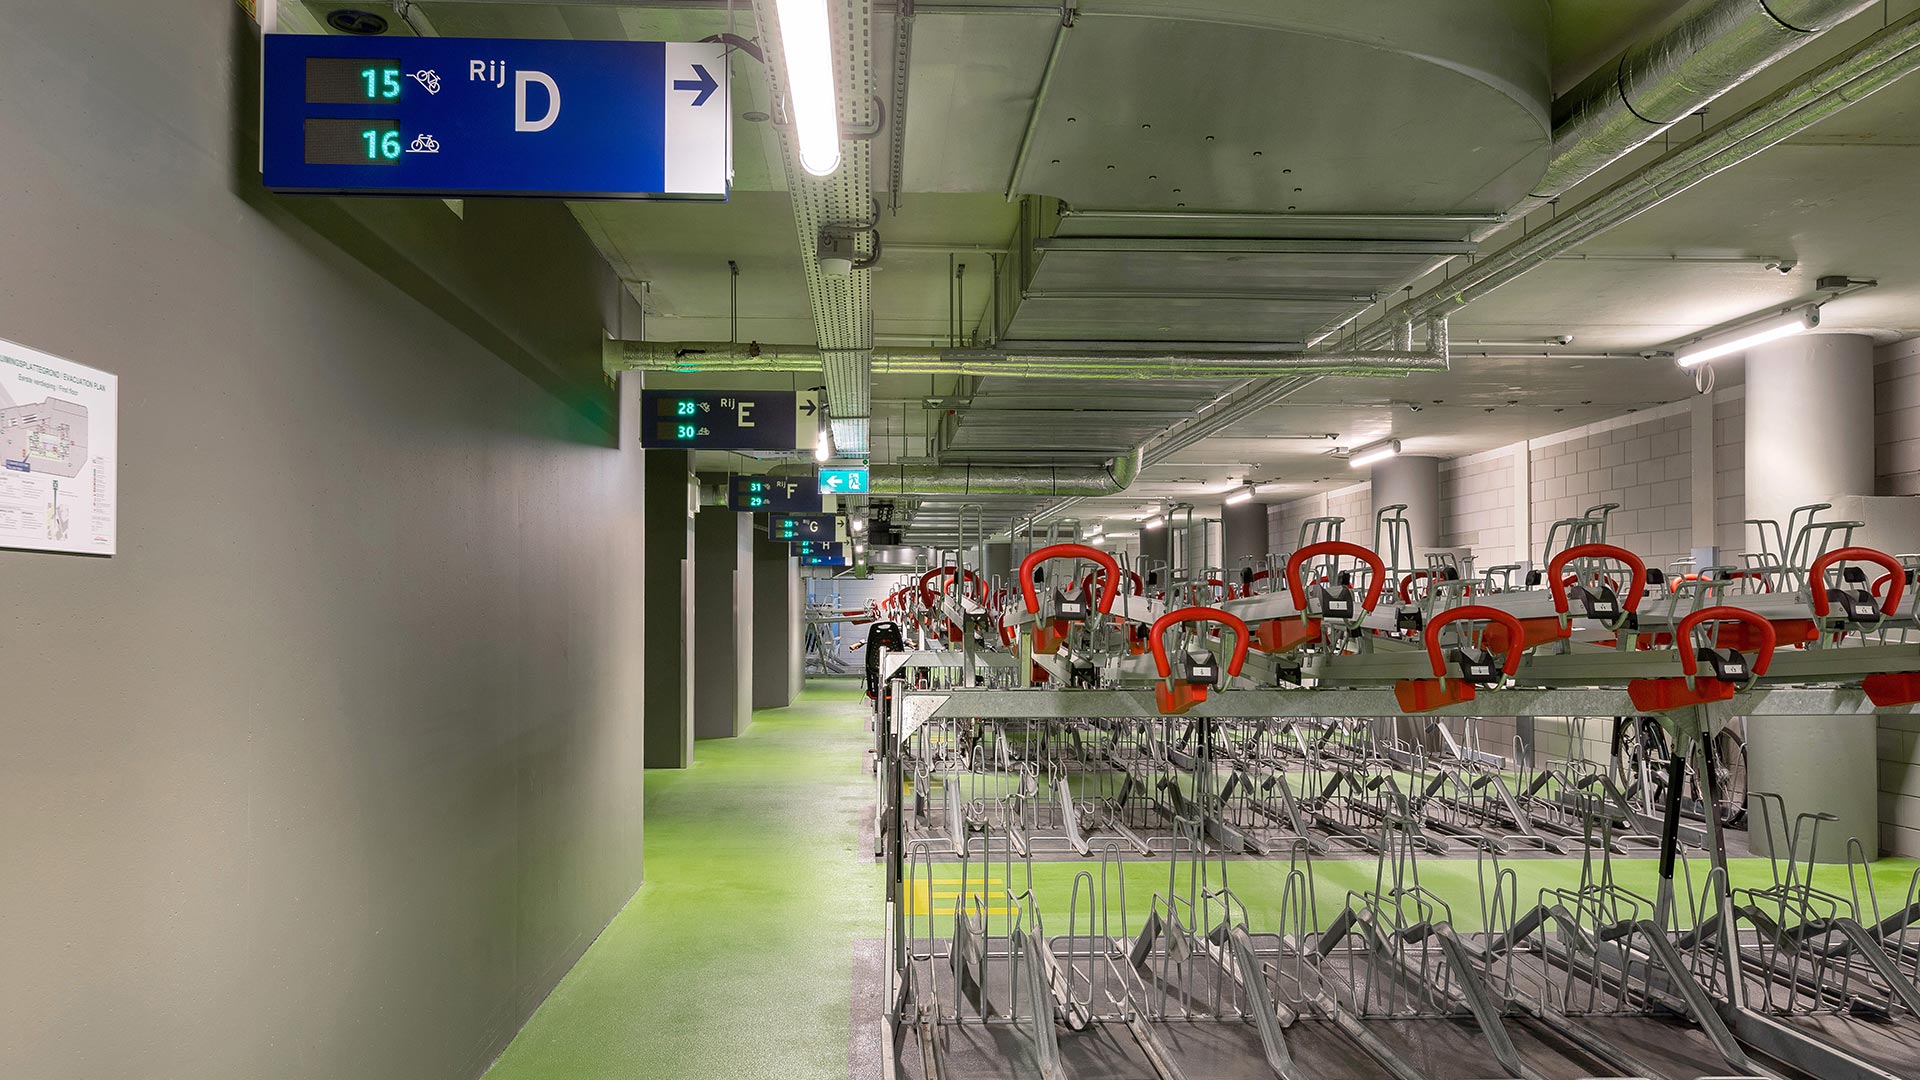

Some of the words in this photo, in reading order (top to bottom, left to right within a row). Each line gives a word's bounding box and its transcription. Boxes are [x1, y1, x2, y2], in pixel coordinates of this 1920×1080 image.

[361, 69, 400, 98] 15
[469, 59, 506, 88] Rij
[515, 70, 562, 132] D
[362, 129, 400, 159] 16
[678, 402, 695, 415] 28
[720, 398, 735, 410] Rij
[738, 402, 755, 427] E
[678, 425, 695, 438] 30
[750, 483, 761, 492] 31
[787, 483, 798, 499] F
[750, 497, 762, 506] 29
[784, 520, 793, 528] 28
[809, 520, 819, 533] G
[784, 530, 793, 538] 28
[822, 541, 830, 550] H
